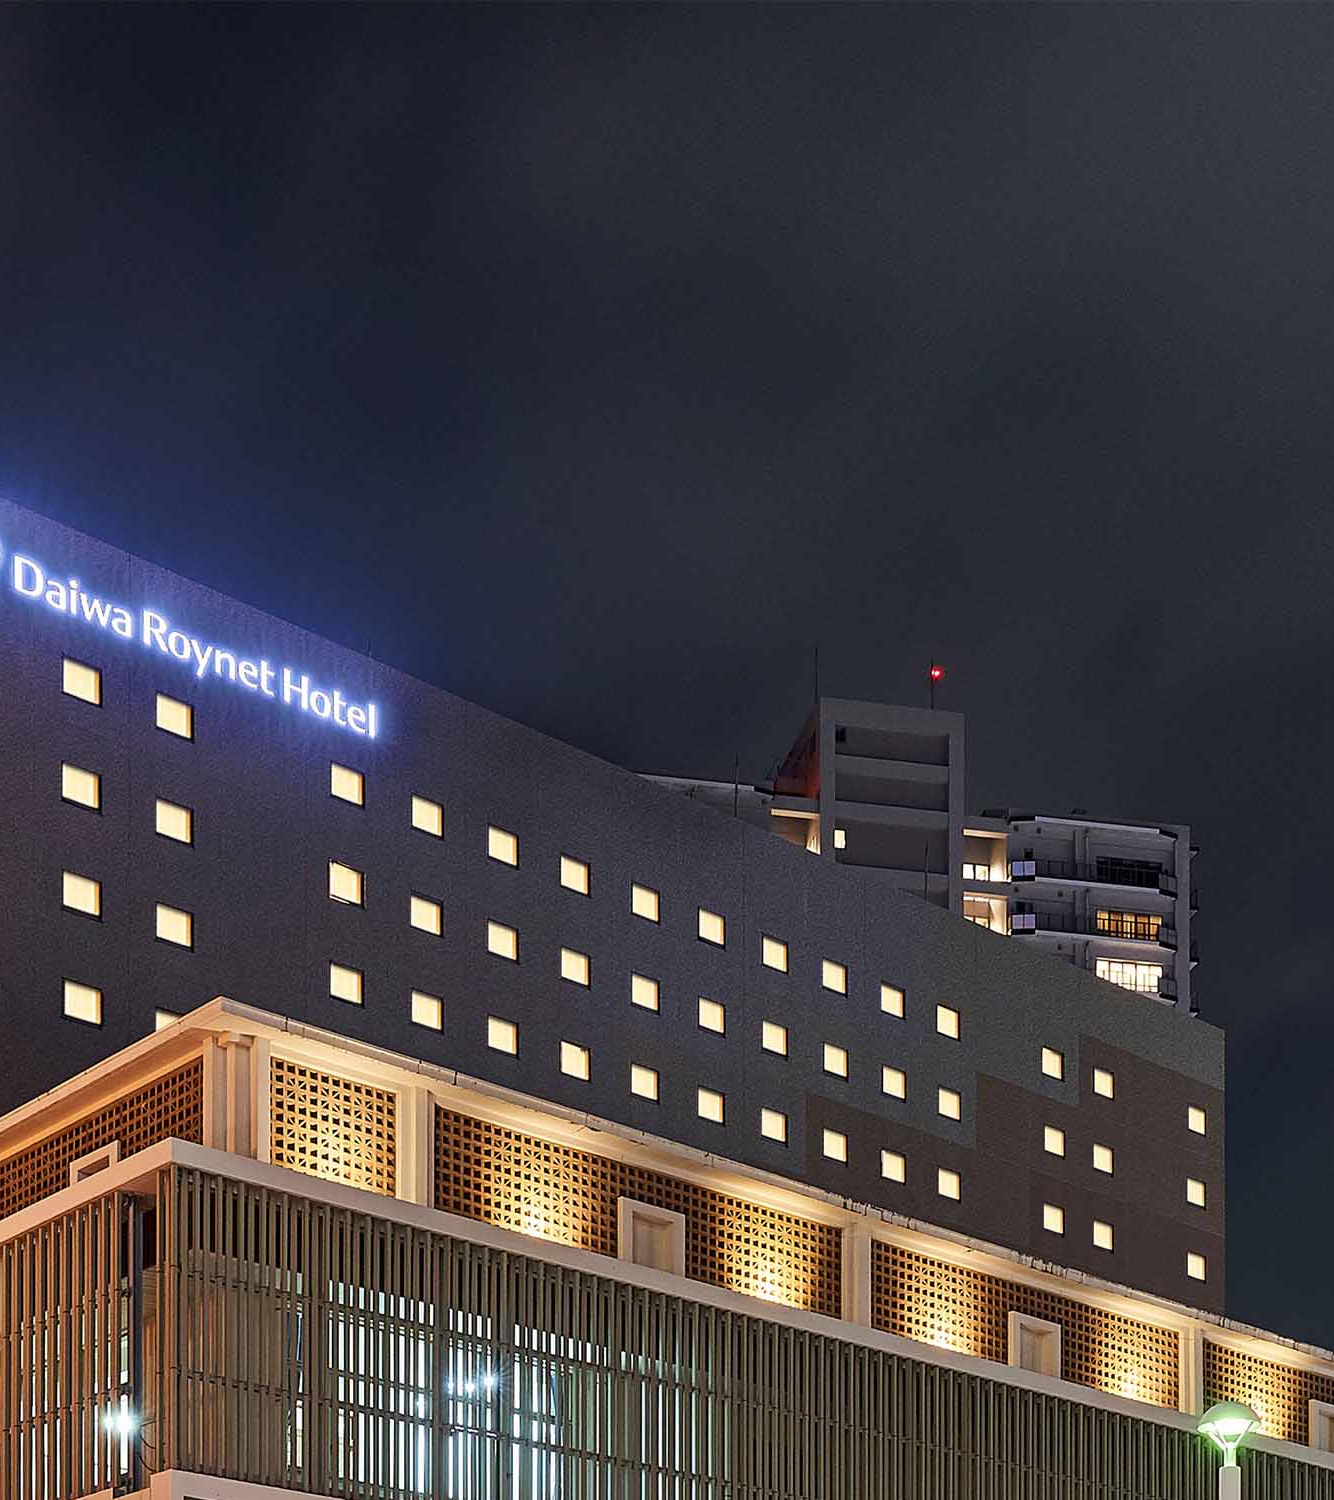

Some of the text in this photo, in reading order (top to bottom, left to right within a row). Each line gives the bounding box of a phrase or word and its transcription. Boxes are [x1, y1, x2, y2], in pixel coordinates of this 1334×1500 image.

[14, 554, 132, 638] Daiwa
[142, 610, 275, 697] Roynet
[283, 667, 377, 738] Hotel
